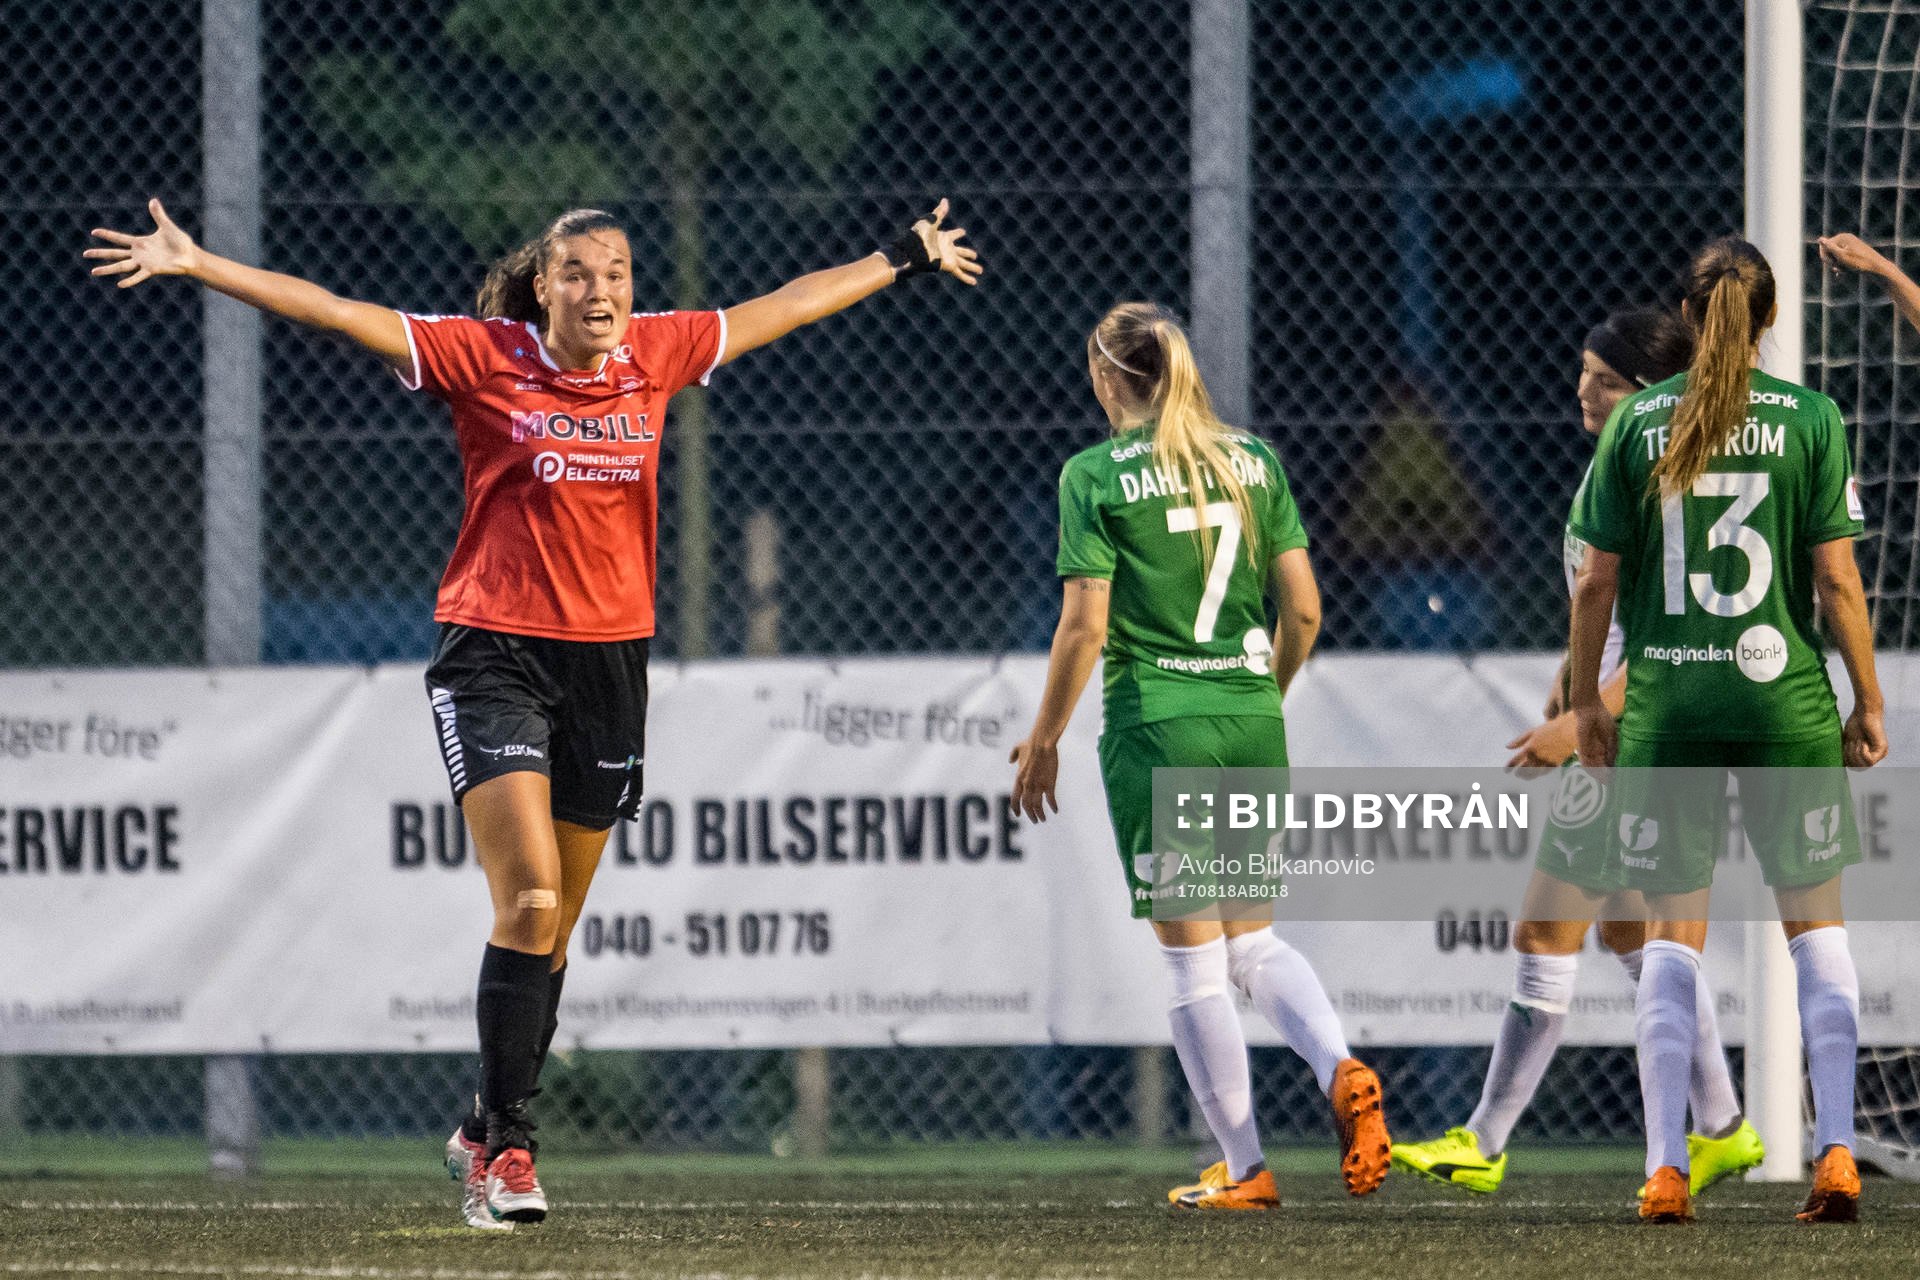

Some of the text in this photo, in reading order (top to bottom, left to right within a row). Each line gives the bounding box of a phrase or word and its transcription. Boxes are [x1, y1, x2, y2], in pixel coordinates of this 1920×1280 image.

[1634, 394, 1683, 416] Sefin
[510, 410, 656, 443] MOBILL
[566, 468, 641, 482] ELECTRA
[568, 453, 645, 467] PRINTHUSET
[1659, 472, 1773, 618] 13
[1166, 501, 1243, 643] 7
[1157, 655, 1247, 674] marginalen
[1644, 643, 1782, 666] marginalen bank
[693, 794, 1024, 866] BILSERVICE
[582, 914, 652, 958] 040
[686, 913, 728, 956] 51
[1435, 908, 1510, 953] 040
